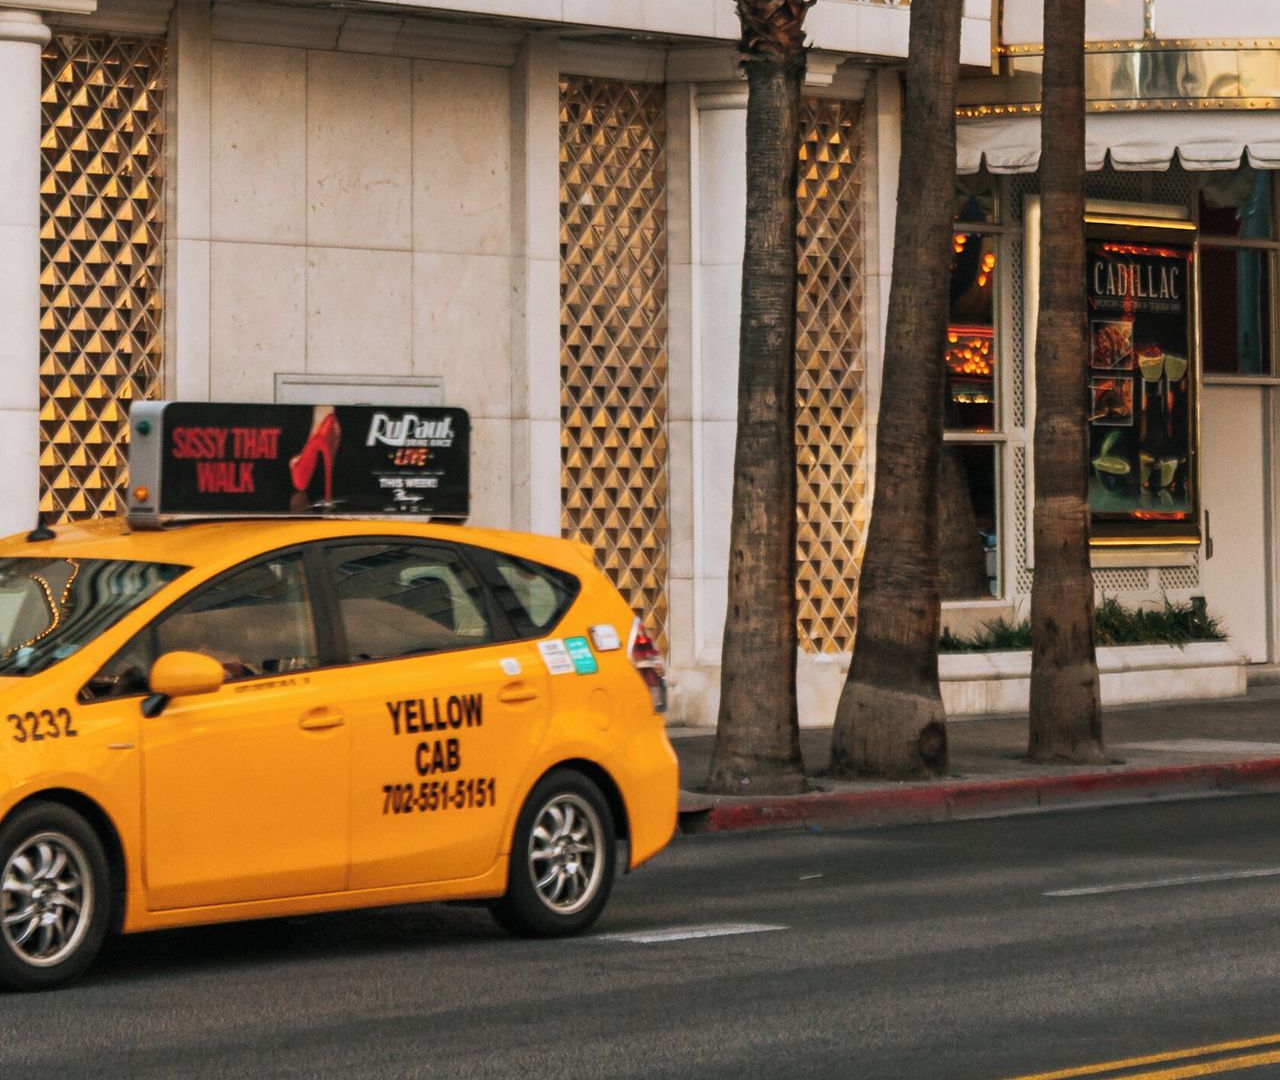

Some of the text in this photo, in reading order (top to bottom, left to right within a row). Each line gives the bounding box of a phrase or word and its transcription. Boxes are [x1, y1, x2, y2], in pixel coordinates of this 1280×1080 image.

[1094, 262, 1179, 299] CADILLAC
[172, 427, 281, 459] SISSY THAT
[196, 461, 256, 494] WALK
[6, 707, 79, 743] 3232
[386, 693, 483, 735] YELLOW
[415, 738, 462, 776] CAB
[382, 778, 497, 815] 702-551-5151
